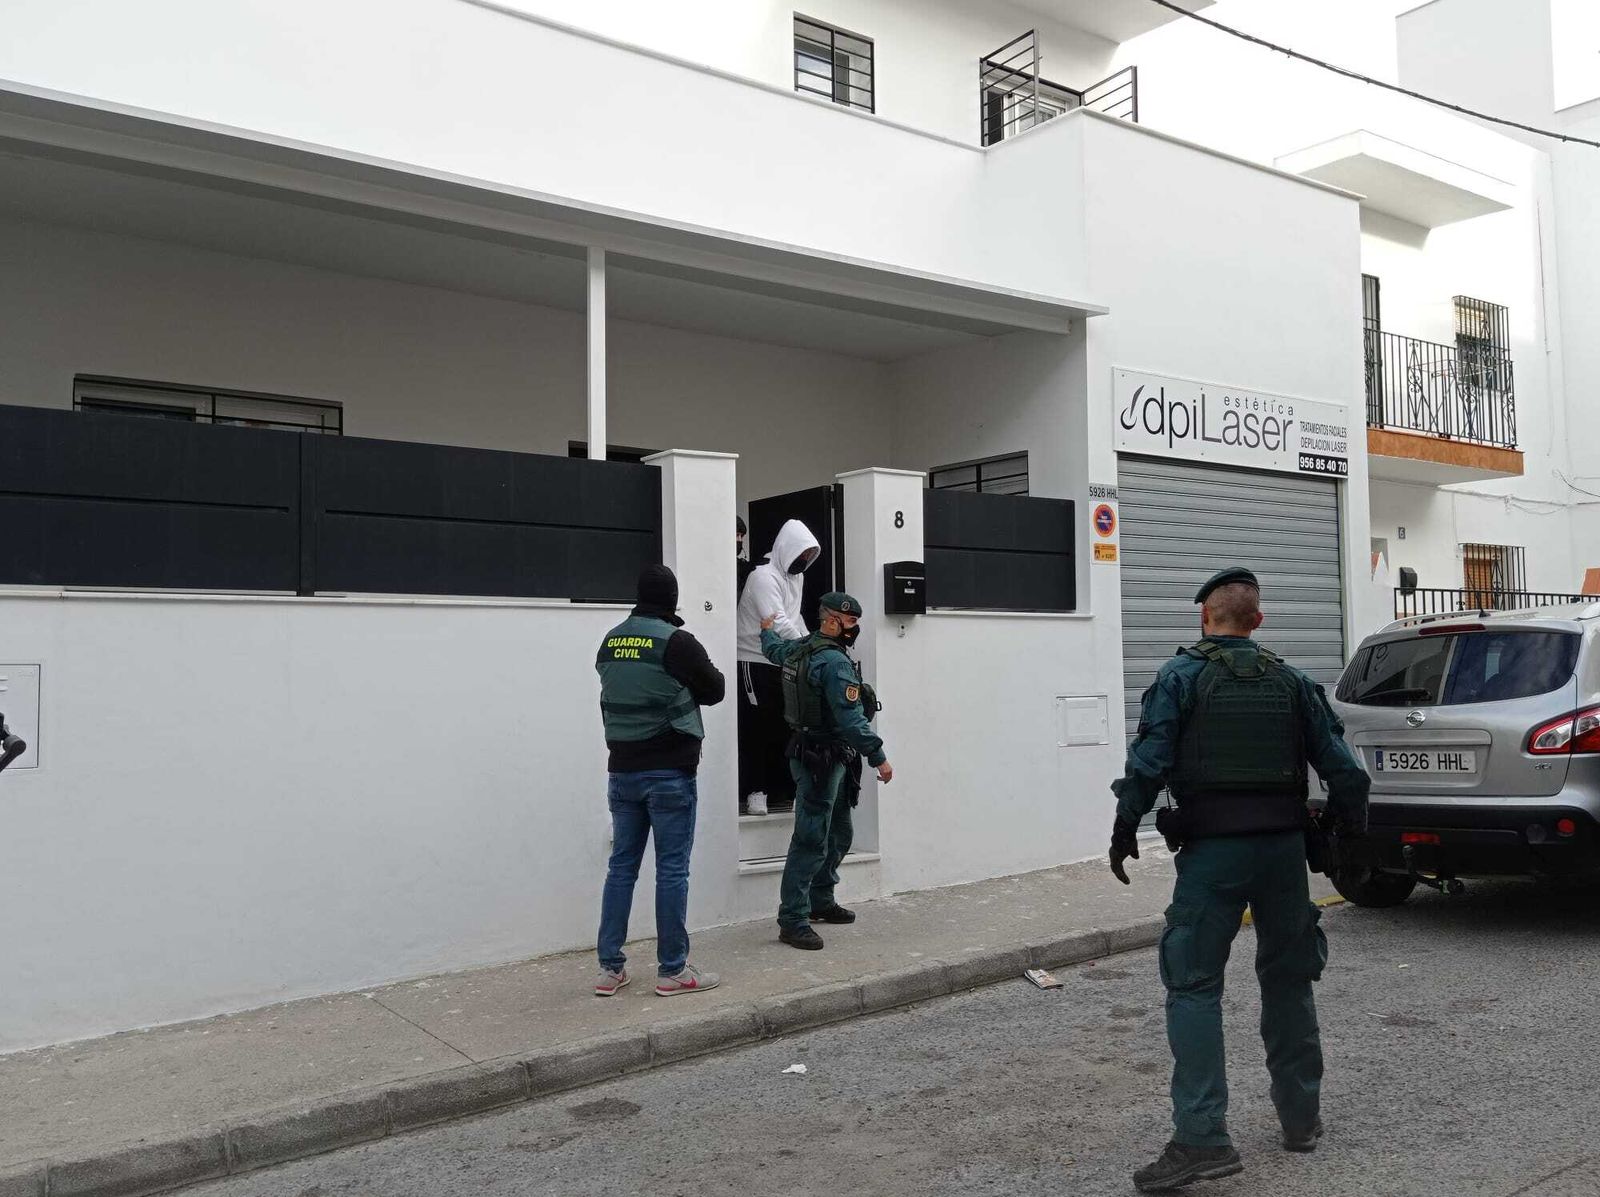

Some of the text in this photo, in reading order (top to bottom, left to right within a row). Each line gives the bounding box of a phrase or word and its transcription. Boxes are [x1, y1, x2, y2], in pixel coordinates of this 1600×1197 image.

[1299, 420, 1347, 438] TRATAMIENTOS FACIALES
[1300, 436, 1347, 453] DEPILACION LASER
[1300, 456, 1347, 473] 956 85 40 70
[894, 510, 905, 529] 8
[607, 637, 653, 649] GUARDIA
[614, 648, 641, 659] CIVIL
[1389, 752, 1470, 771] 5926 HHL
